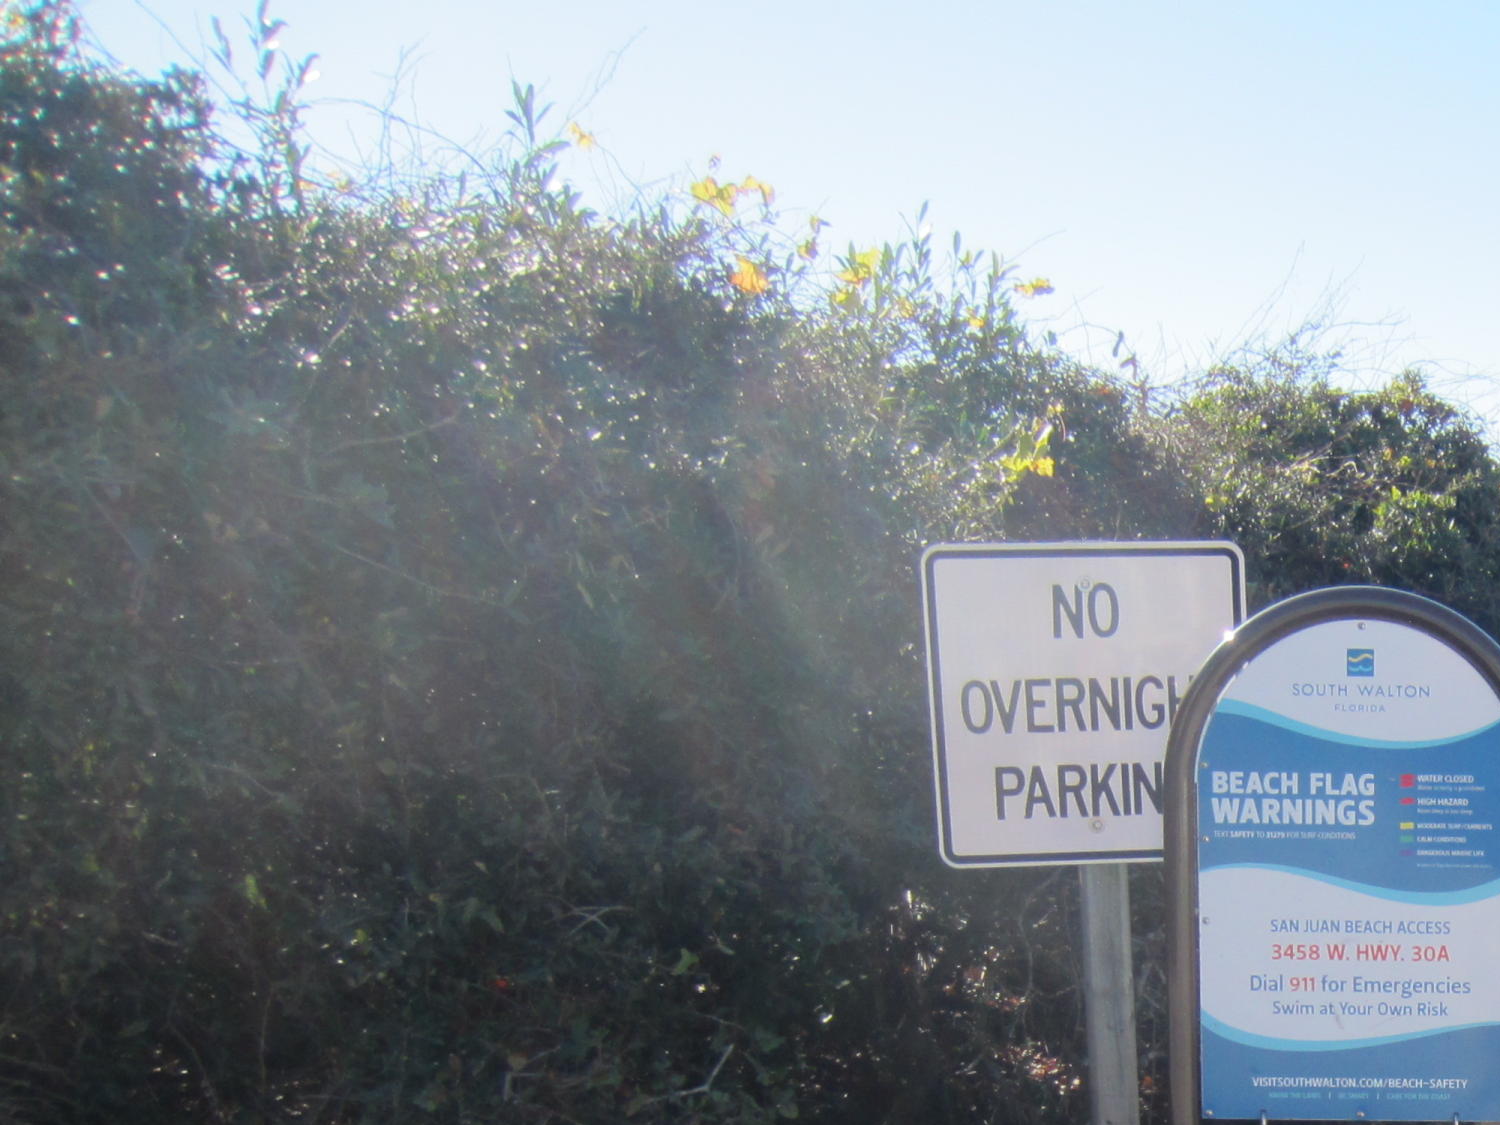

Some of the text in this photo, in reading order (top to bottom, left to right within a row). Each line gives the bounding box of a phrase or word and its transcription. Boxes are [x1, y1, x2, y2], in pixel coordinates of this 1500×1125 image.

[1052, 582, 1119, 639] NO
[1292, 683, 1431, 698] SOUTH WALTON
[960, 674, 1193, 735] OVERNIGH
[1334, 703, 1386, 713] FLORIDA
[1211, 771, 1375, 796] BEACH FLAG
[1417, 774, 1475, 783] WATER CLOSED
[994, 761, 1164, 820] PARKIN
[1417, 798, 1469, 806] HIGH HAZARD
[1211, 797, 1376, 825] WARNINGS
[1214, 830, 1230, 838] TEXT
[1230, 830, 1254, 839] SAFETY
[1256, 831, 1265, 839] TO
[1286, 831, 1299, 839] FOR
[1270, 919, 1451, 935] SAN JUAN BEACH ACCESS
[1271, 944, 1450, 962] 3458 W. HWY. 30A
[1250, 975, 1471, 998] Dial 911 for Emergencies
[1272, 1001, 1449, 1016] Swim at Your Own Risk
[1252, 1076, 1468, 1089] VISITSOUTHWALTON.COM/BEACH-SAFETY
